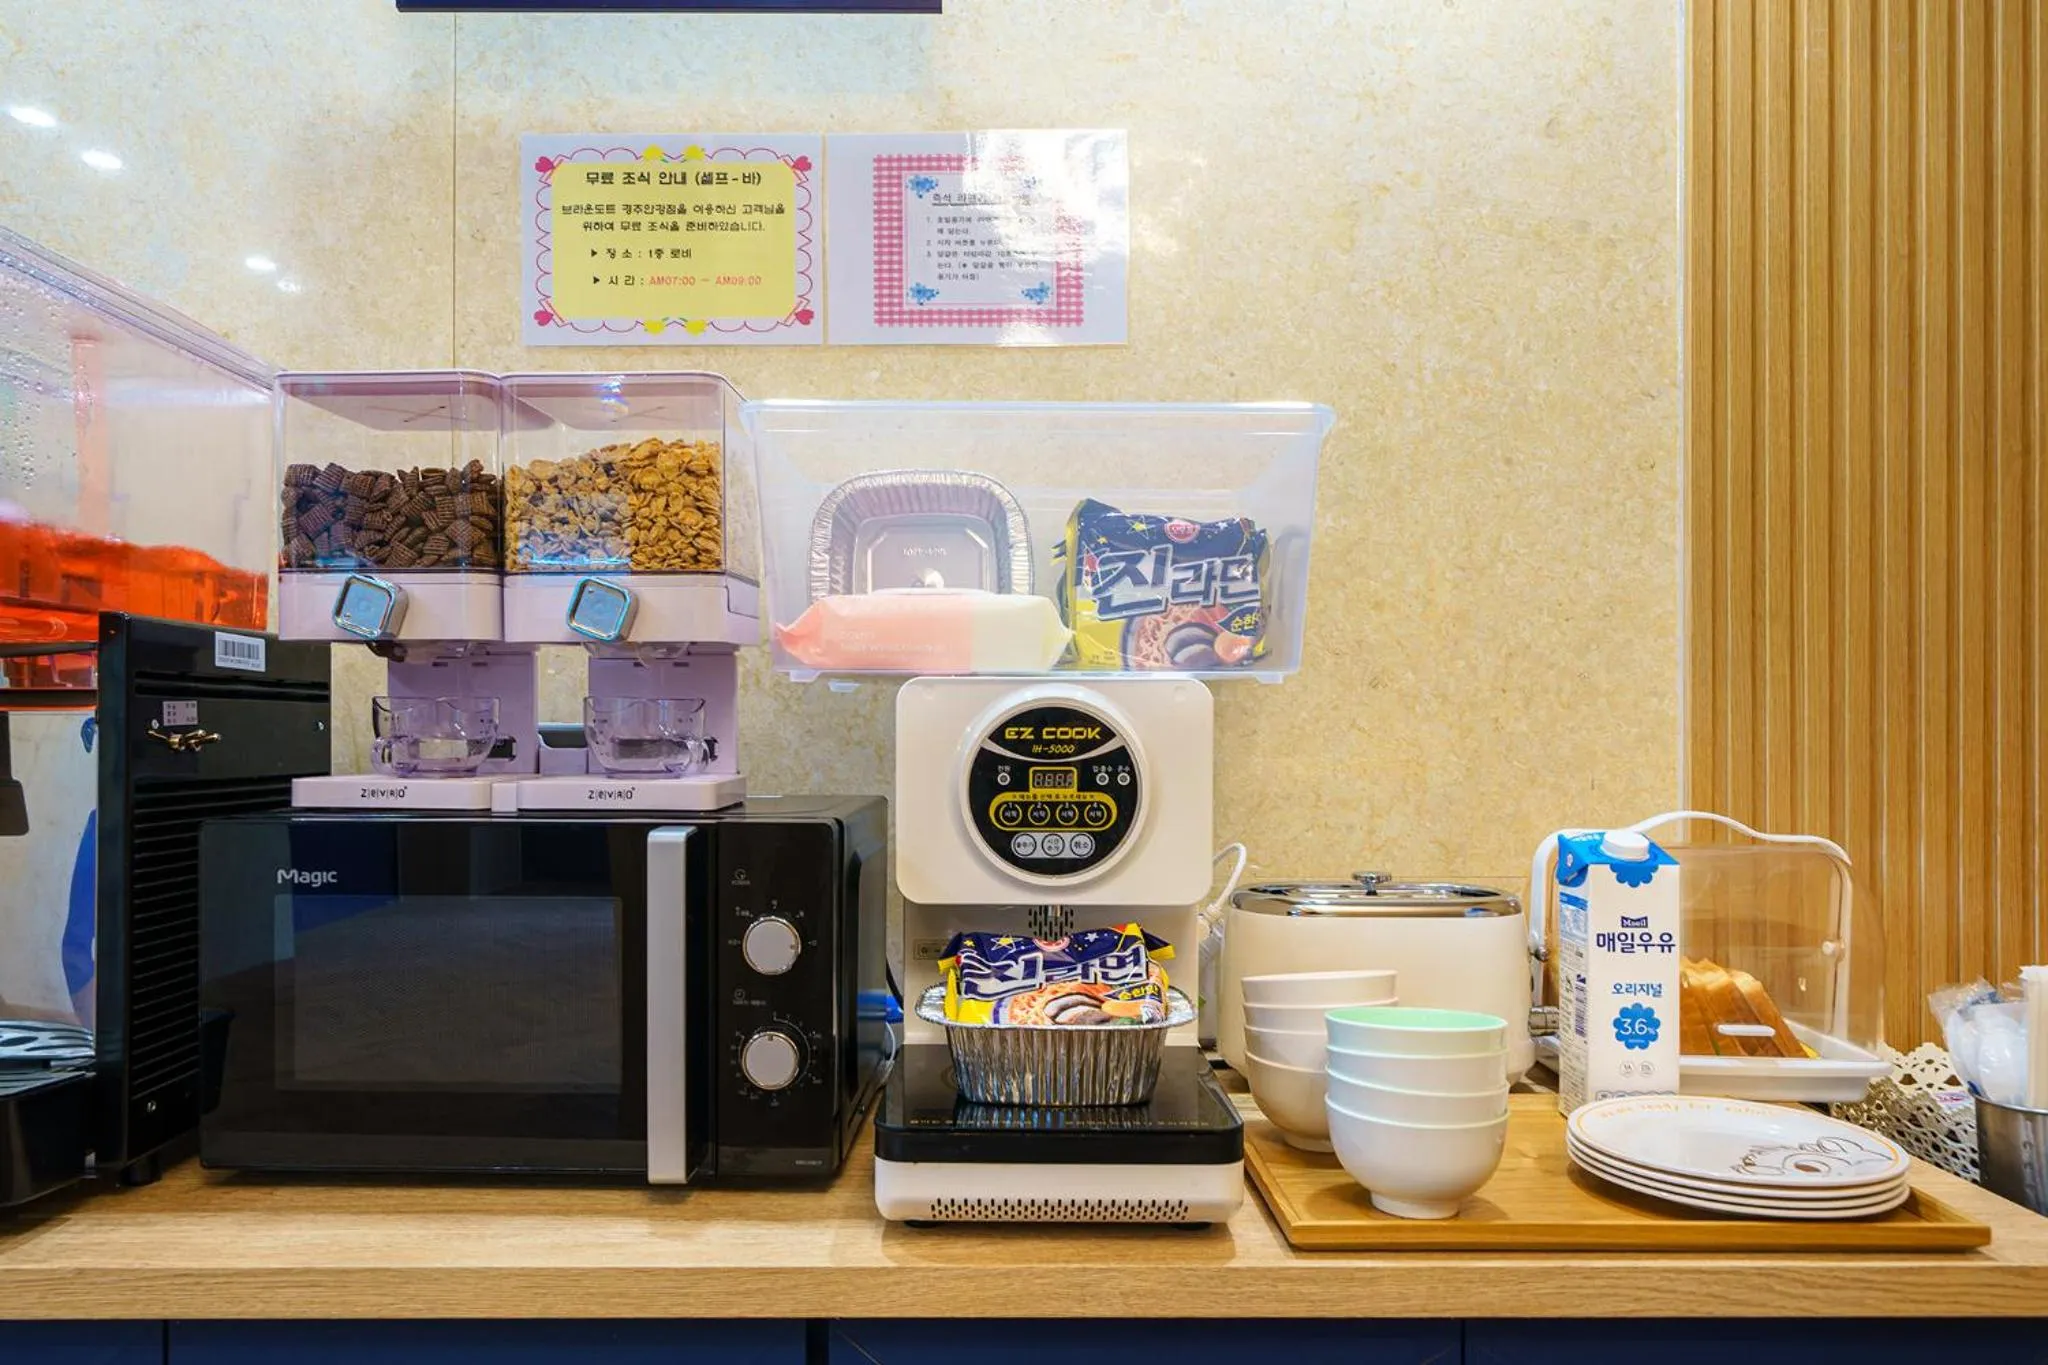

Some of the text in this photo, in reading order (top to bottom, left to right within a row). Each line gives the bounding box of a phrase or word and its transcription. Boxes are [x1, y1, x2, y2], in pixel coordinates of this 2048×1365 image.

[586, 171, 614, 185] 무료
[622, 171, 651, 185] 조식
[658, 171, 687, 185] 안내
[562, 204, 616, 215] 브라운도트
[693, 204, 736, 215] 이용하신
[742, 204, 785, 215] 고객님을
[583, 221, 614, 232] 위하여
[620, 221, 642, 232] 무료
[648, 221, 680, 232] 조식을
[649, 248, 665, 259] 1층
[670, 248, 692, 259] 로비
[649, 276, 696, 286] AM07:00
[715, 276, 762, 286] AM09:00
[1092, 544, 1262, 621] 진라면
[1005, 727, 1101, 739] EZ COOK
[1031, 744, 1076, 753] IH-5000
[1074, 841, 1089, 849] 취소
[277, 869, 338, 887] Magic
[1596, 932, 1676, 954] 매일우유
[1612, 982, 1663, 998] 오리지널
